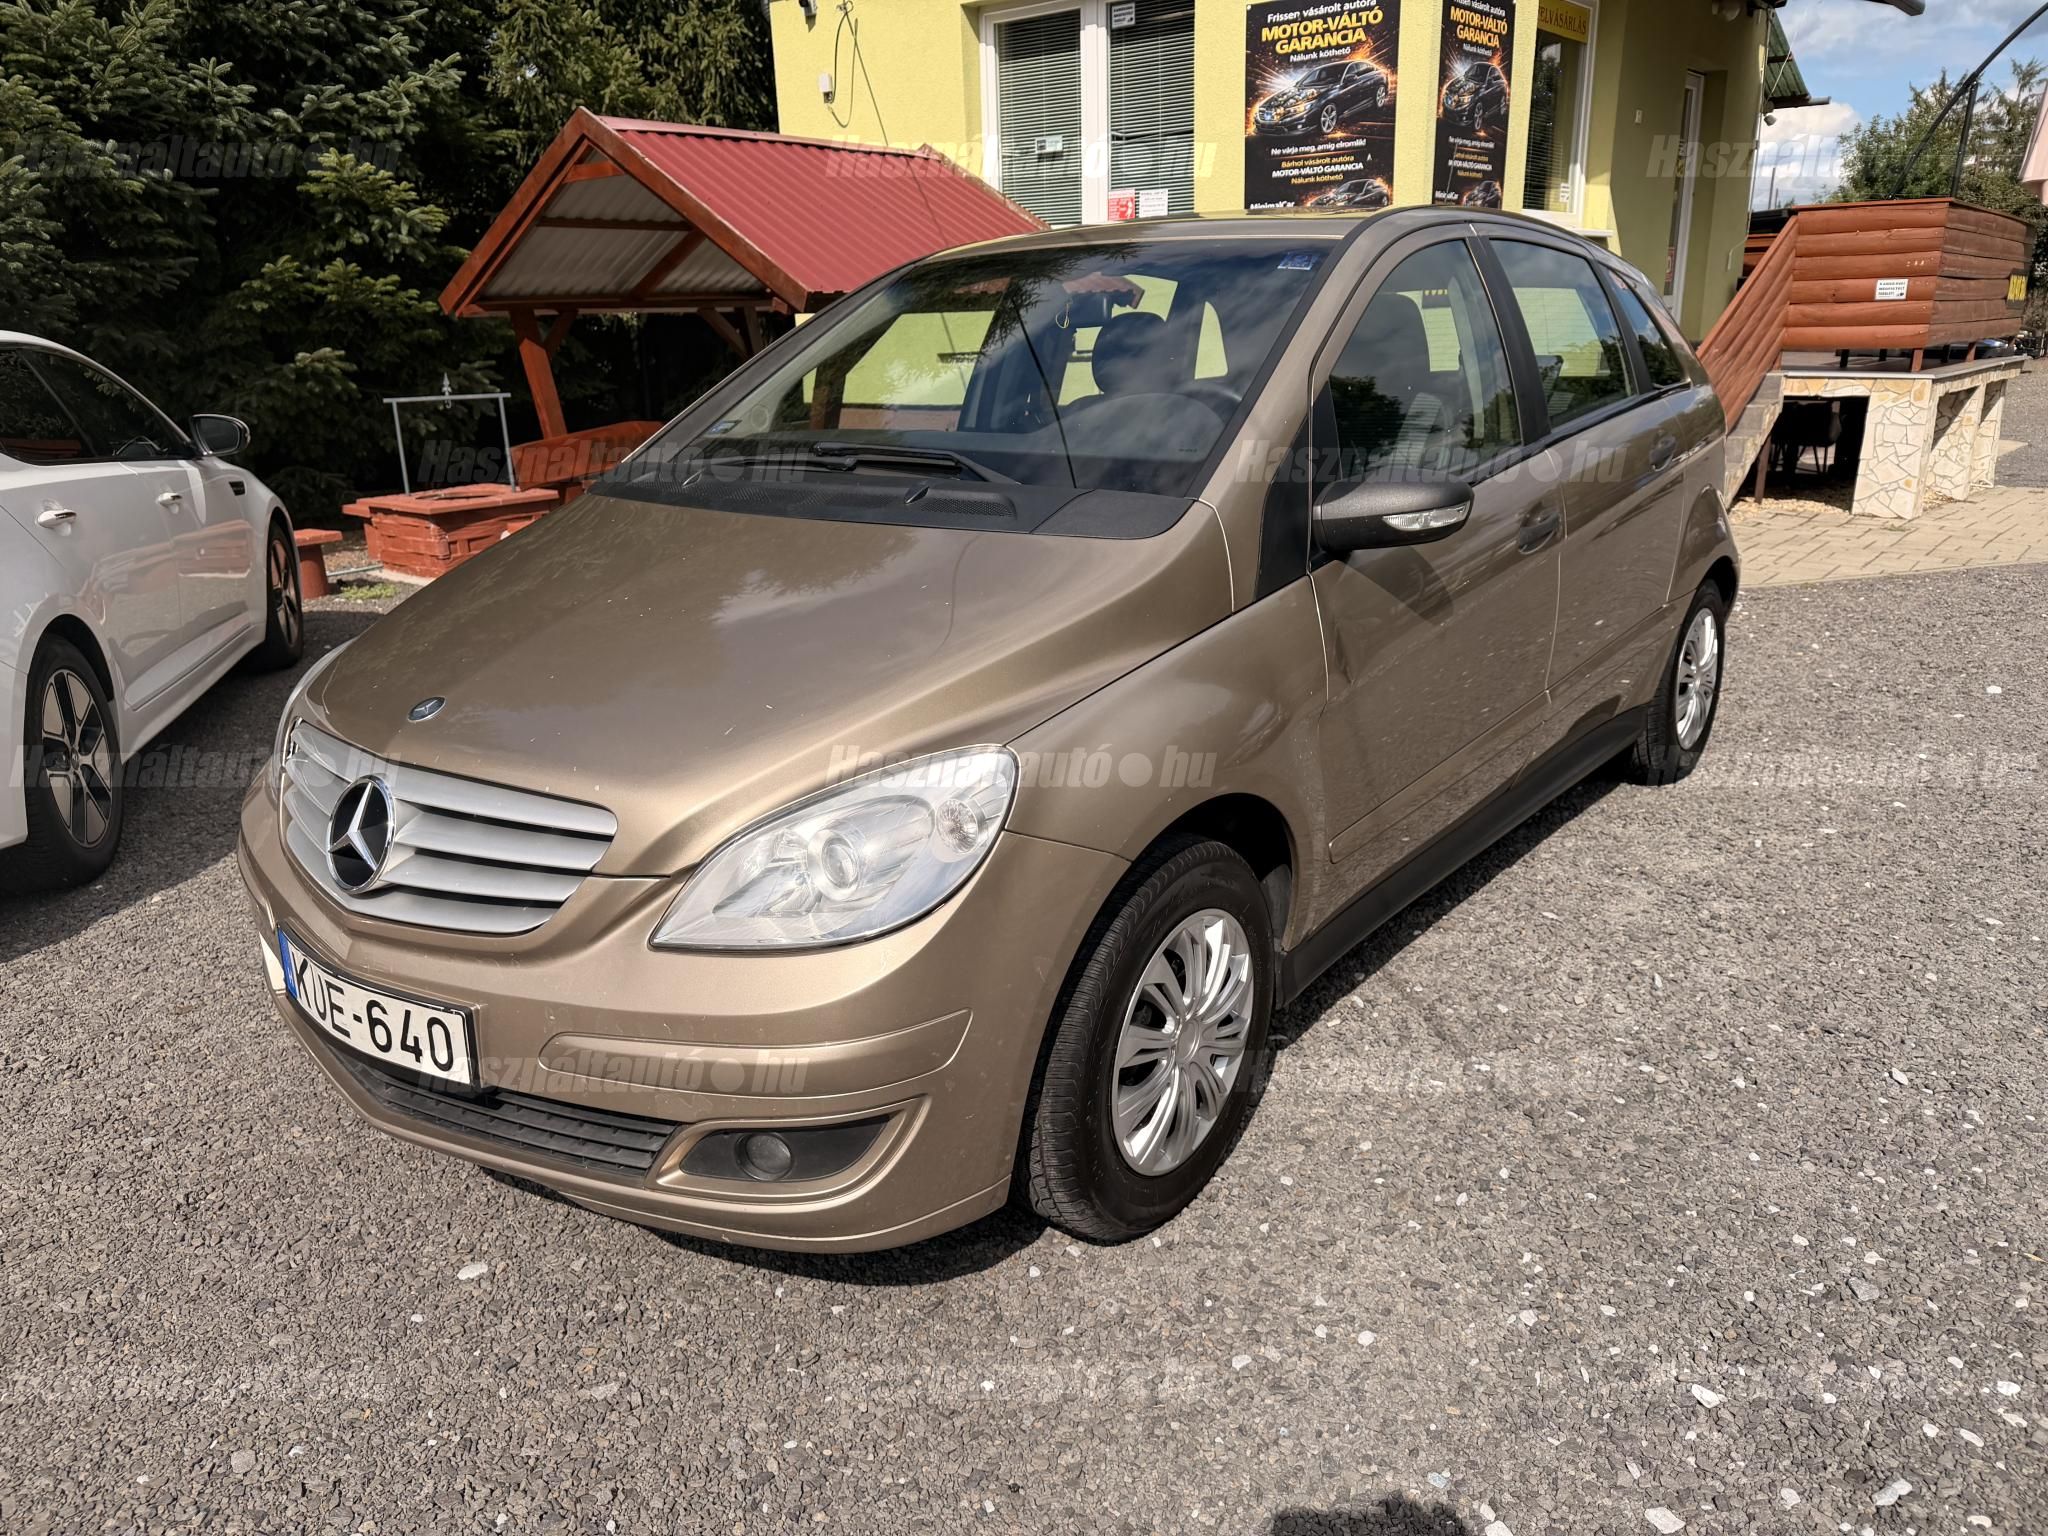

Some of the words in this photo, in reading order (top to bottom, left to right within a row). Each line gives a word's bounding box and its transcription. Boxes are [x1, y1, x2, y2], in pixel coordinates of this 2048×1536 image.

[1267, 11, 1300, 23] Frissen
[1303, 2, 1342, 17] vásárolt
[1450, 6, 1508, 35] MOTOR-VÁLTÓ
[1261, 6, 1383, 42] MOTOR-VÁLTÓ
[1275, 28, 1367, 55] GARANCIA
[1456, 25, 1500, 48] GARANCIA
[1290, 51, 1318, 62] Nálunk
[1319, 46, 1351, 59] köthető
[1331, 155, 1355, 163] autóra
[1272, 166, 1324, 178] MOTOR-VÁLTÓ
[1324, 163, 1364, 173] GARANCIA
[1291, 176, 1316, 185] Nálunk
[291, 950, 454, 1072] KUE-640
